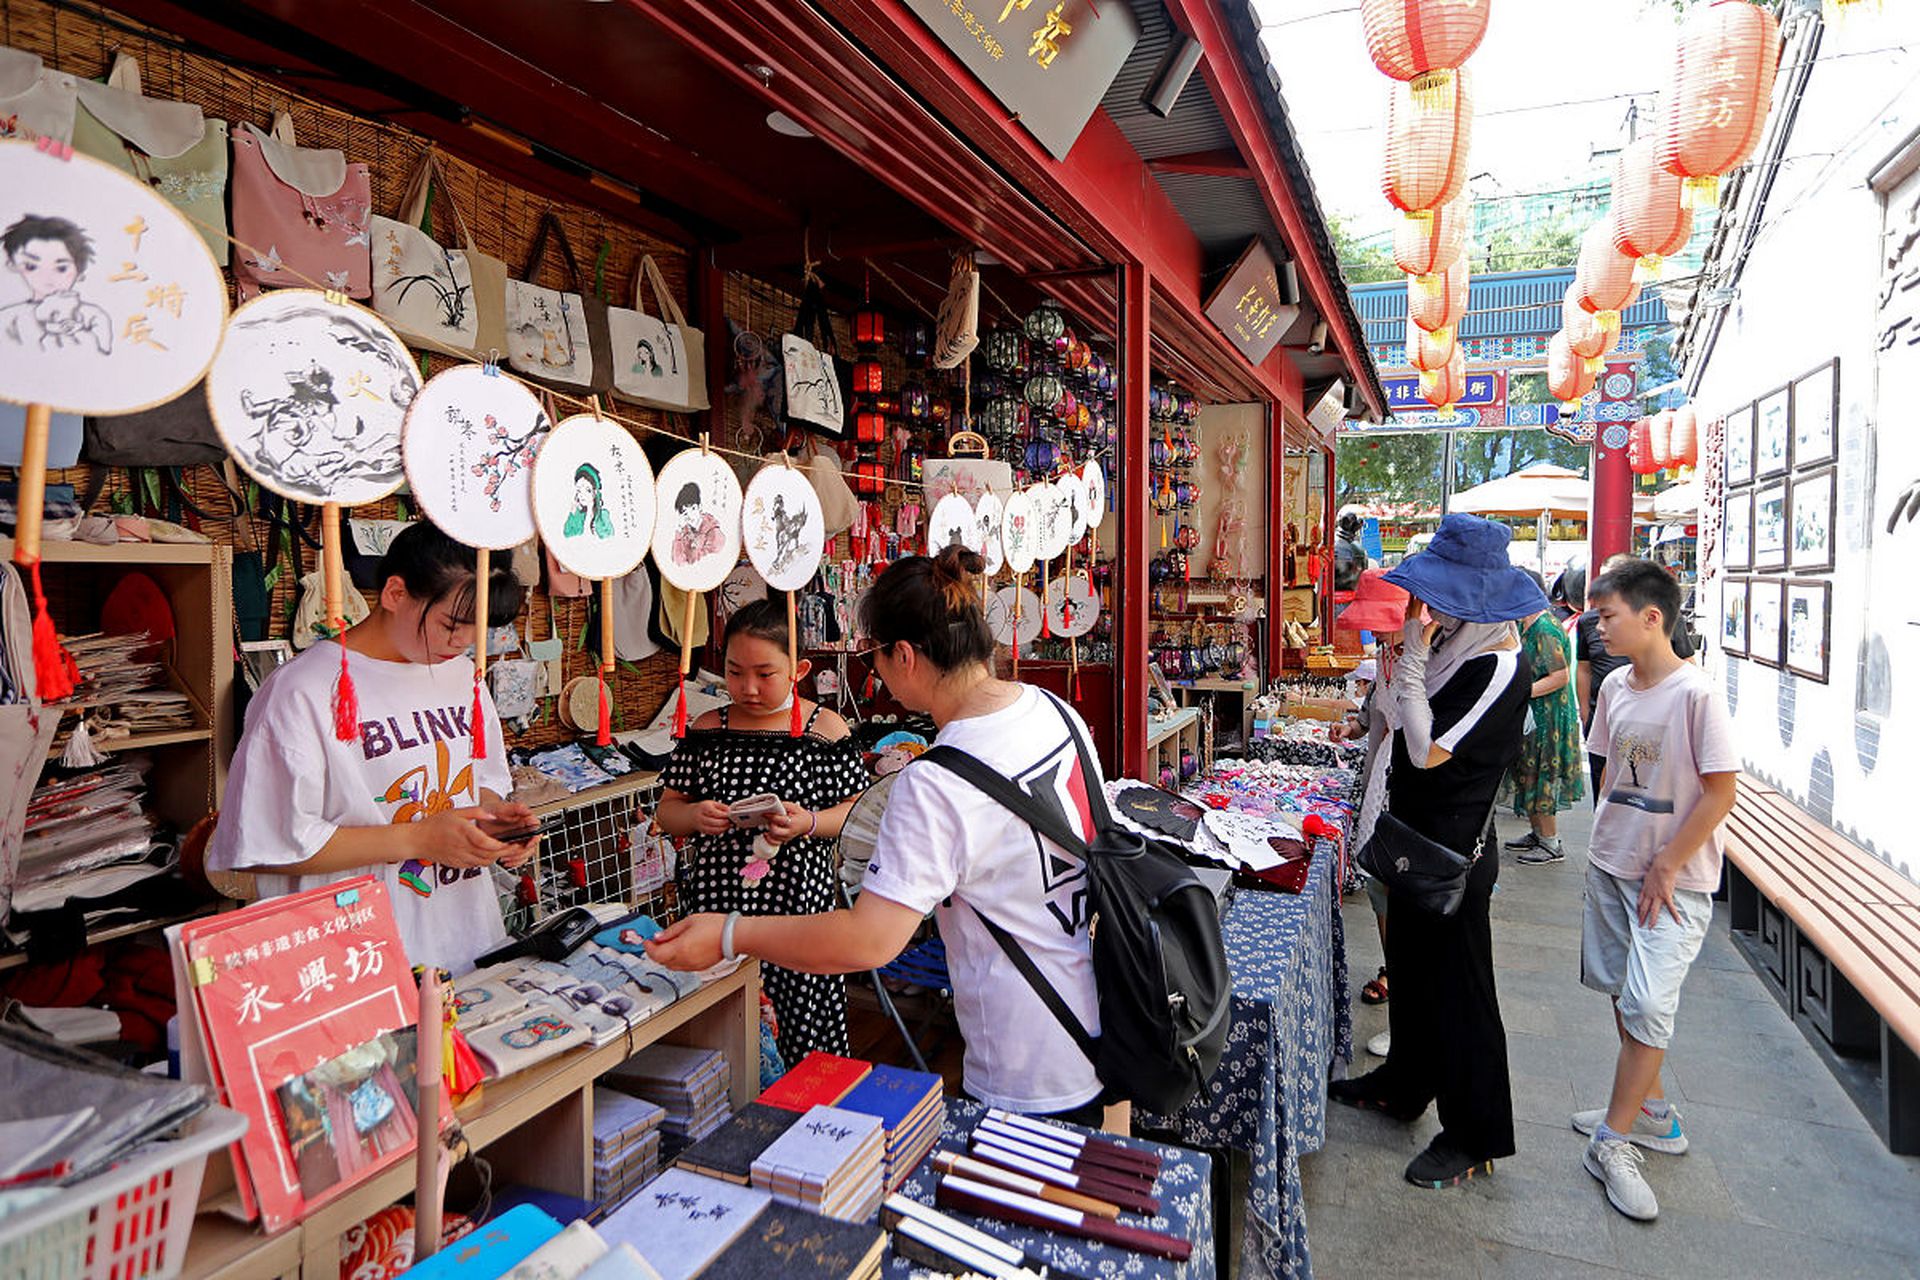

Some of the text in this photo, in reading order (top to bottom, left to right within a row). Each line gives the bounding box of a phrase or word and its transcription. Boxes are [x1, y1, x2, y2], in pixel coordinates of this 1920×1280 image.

[345, 370, 384, 401] 火
[358, 706, 474, 760] BLINK
[236, 941, 388, 1025] 永興坊
